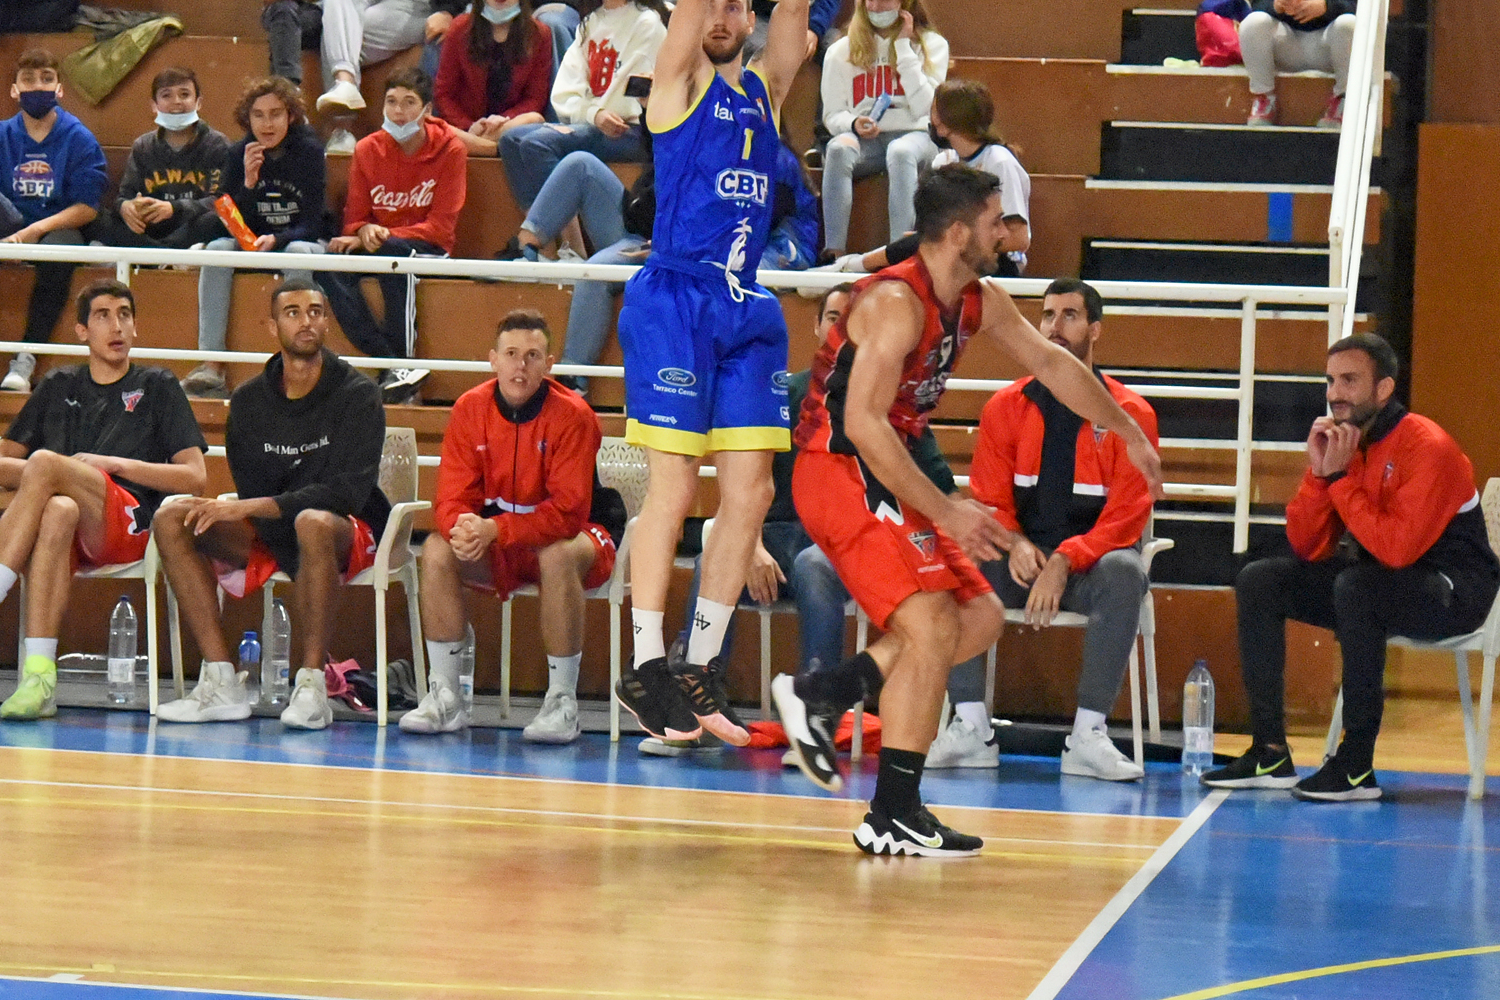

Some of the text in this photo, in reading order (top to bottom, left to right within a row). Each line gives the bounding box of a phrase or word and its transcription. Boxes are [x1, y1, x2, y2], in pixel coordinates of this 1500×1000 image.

[742, 127, 755, 160] 1
[716, 168, 768, 205] CBT
[652, 383, 677, 394] Tarraco
[665, 370, 690, 384] Ford
